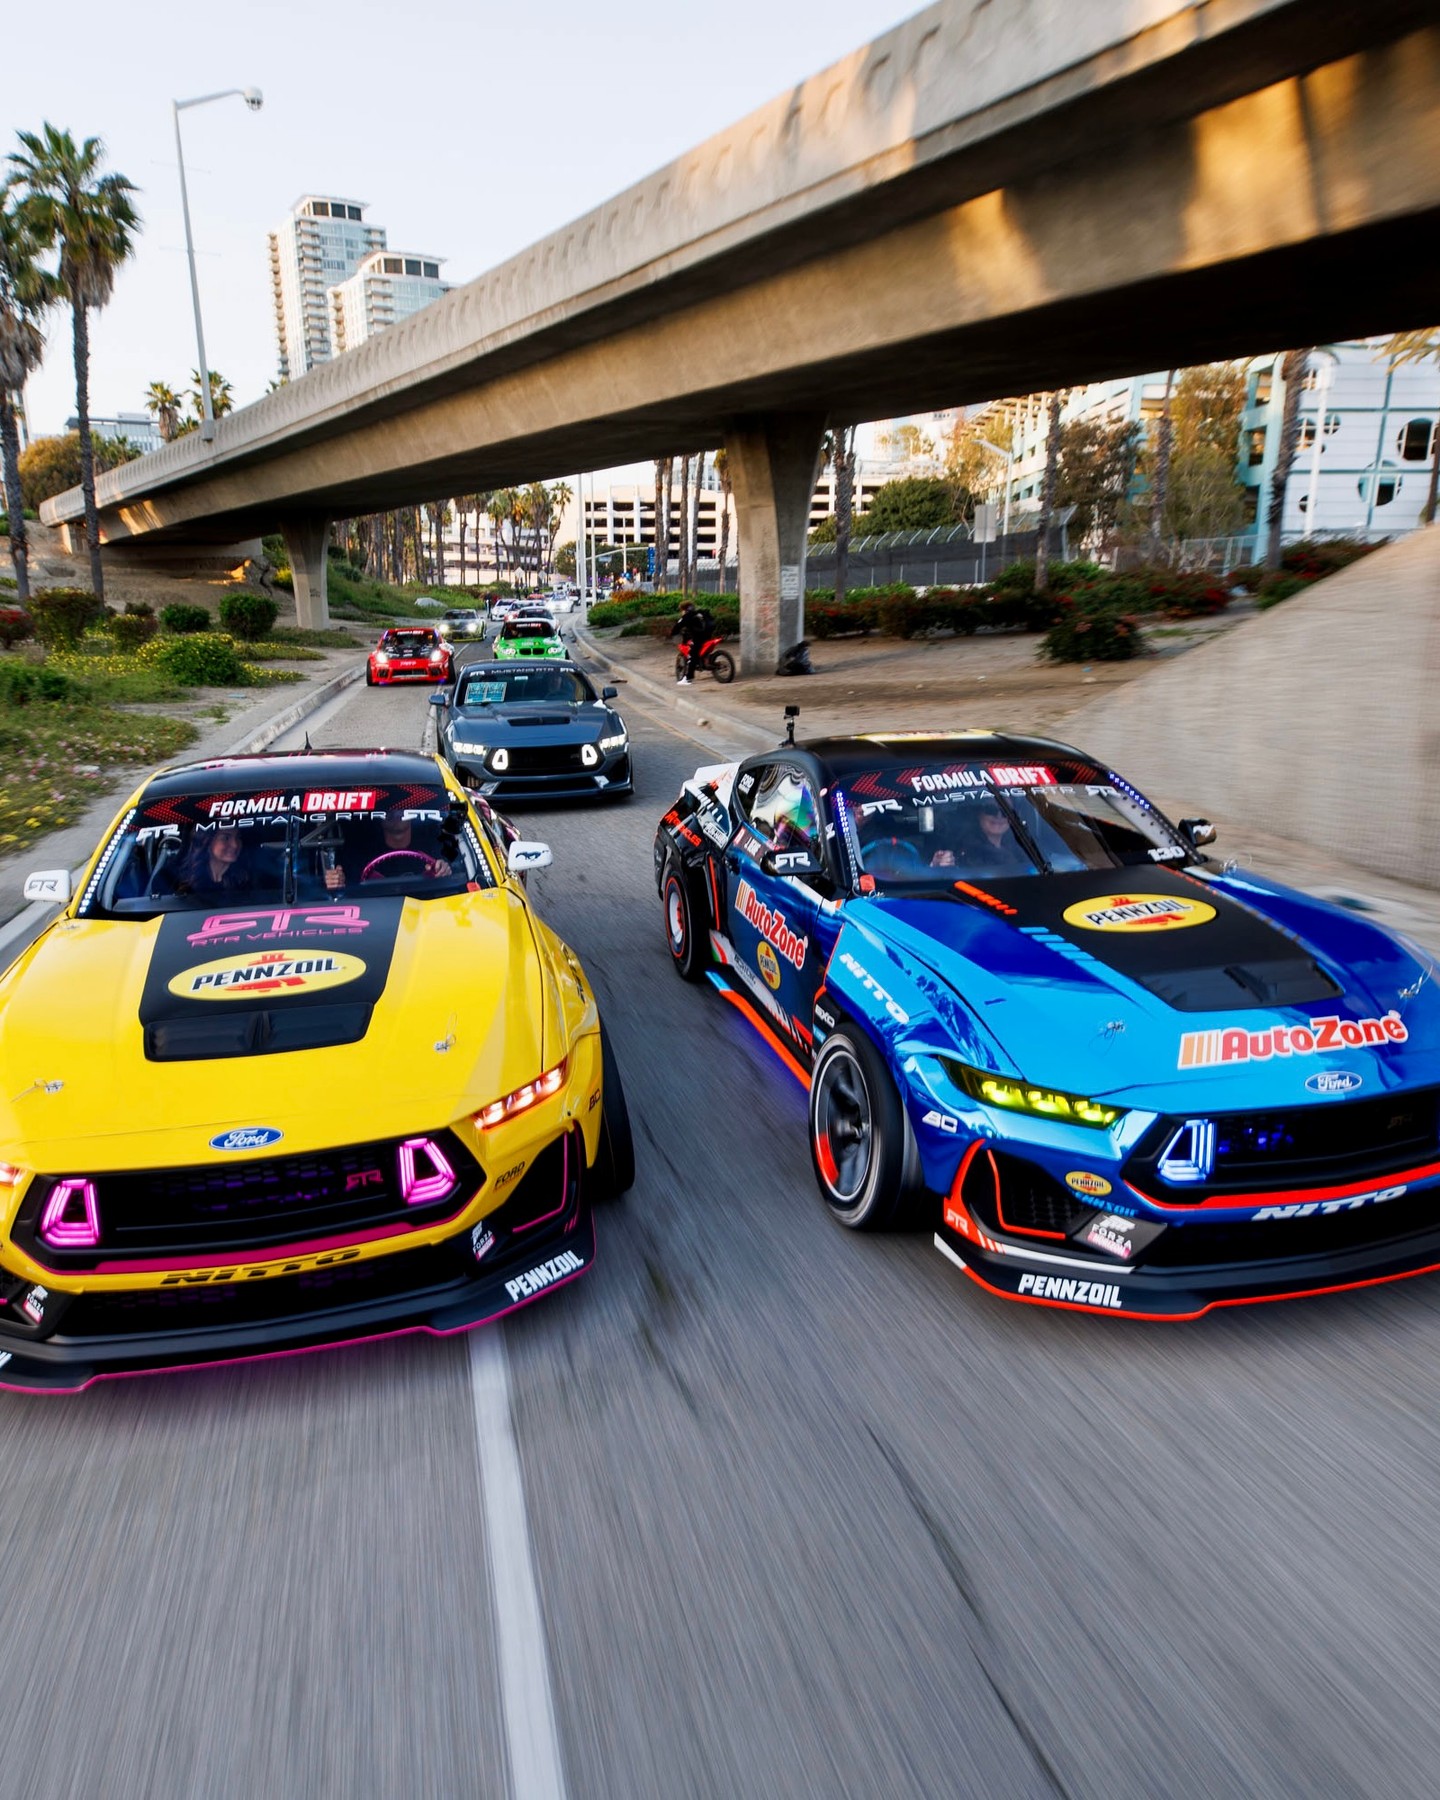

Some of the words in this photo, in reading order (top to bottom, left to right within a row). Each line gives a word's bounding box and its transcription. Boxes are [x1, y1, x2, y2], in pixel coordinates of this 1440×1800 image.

[910, 769, 995, 793] FORMULA
[992, 767, 1052, 785] DRIFT
[208, 795, 301, 818] FORMULA
[306, 792, 372, 811] DRIFT
[195, 813, 327, 832] MUSTANG
[335, 811, 387, 821] RTR
[773, 852, 811, 869] RTR
[1148, 846, 1186, 862] 130
[1083, 899, 1195, 928] PENNZOIL
[246, 927, 363, 941] VEHICLES
[743, 887, 806, 972] AutoZone
[190, 957, 340, 993] PENNZOIL
[839, 952, 910, 1025] NITTO
[1221, 1014, 1409, 1063] AutoZone
[1317, 1073, 1354, 1092] Ford
[224, 1128, 270, 1148] Ford
[495, 1161, 525, 1187] FORD
[1251, 1185, 1407, 1222] NITTO
[473, 1230, 493, 1254] FORZA
[1091, 1223, 1132, 1250] FORZA
[159, 1249, 361, 1285] NITTO
[504, 1249, 584, 1303] PENNZOIL
[1018, 1273, 1122, 1309] PENNZOIL
[26, 1292, 45, 1317] FORZA
